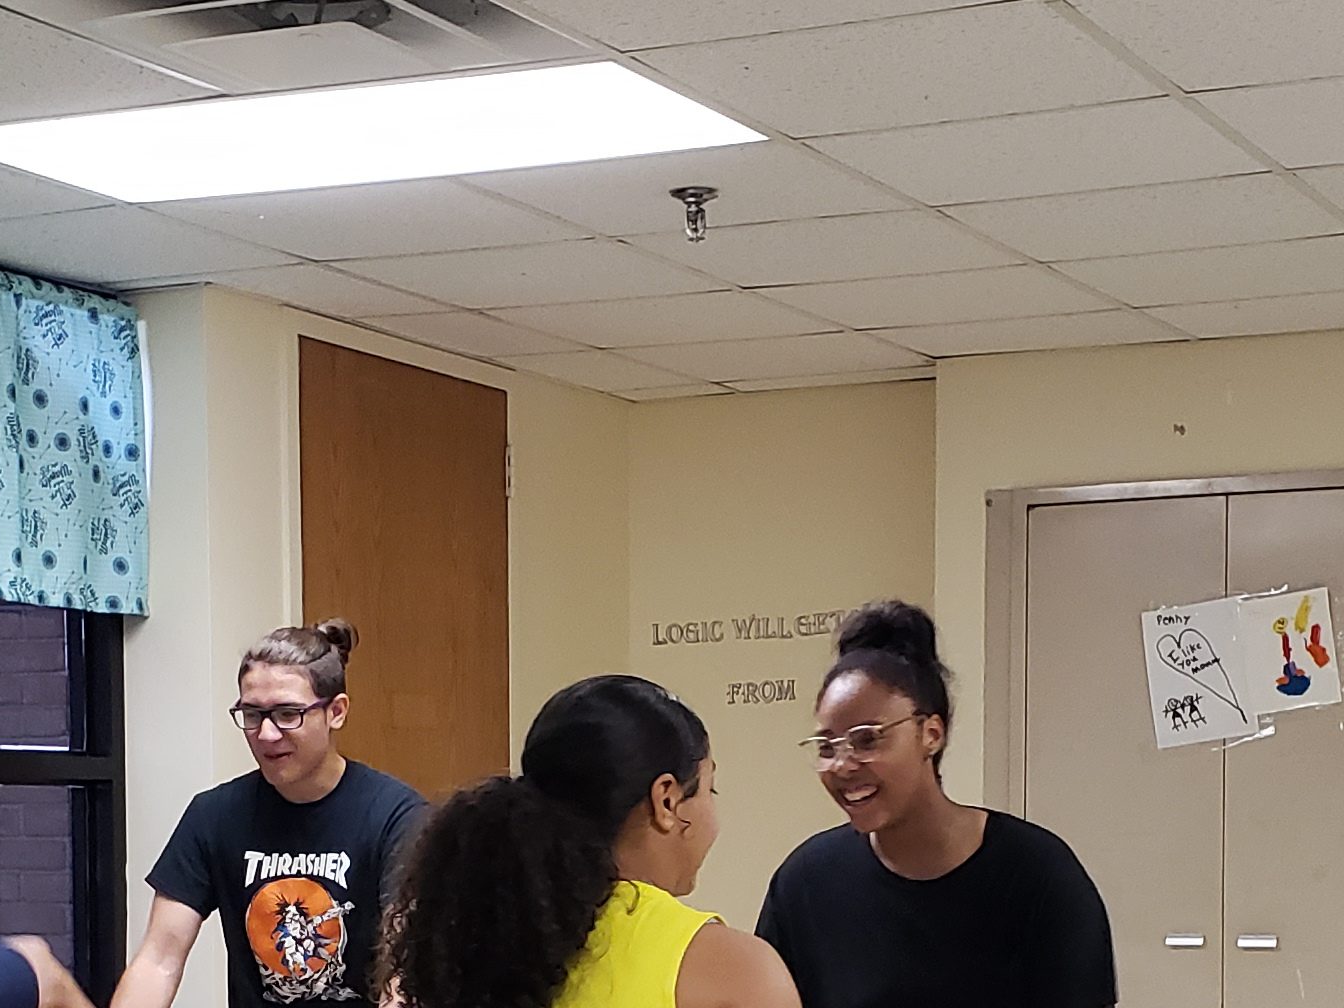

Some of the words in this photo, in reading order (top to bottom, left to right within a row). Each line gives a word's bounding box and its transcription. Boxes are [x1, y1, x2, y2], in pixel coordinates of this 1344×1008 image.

[652, 619, 724, 646] LOGIC
[732, 613, 793, 641] WILL
[1167, 649, 1180, 664] I
[1182, 642, 1203, 657] like
[726, 679, 797, 705] FROM
[243, 850, 352, 890] THRASHER
